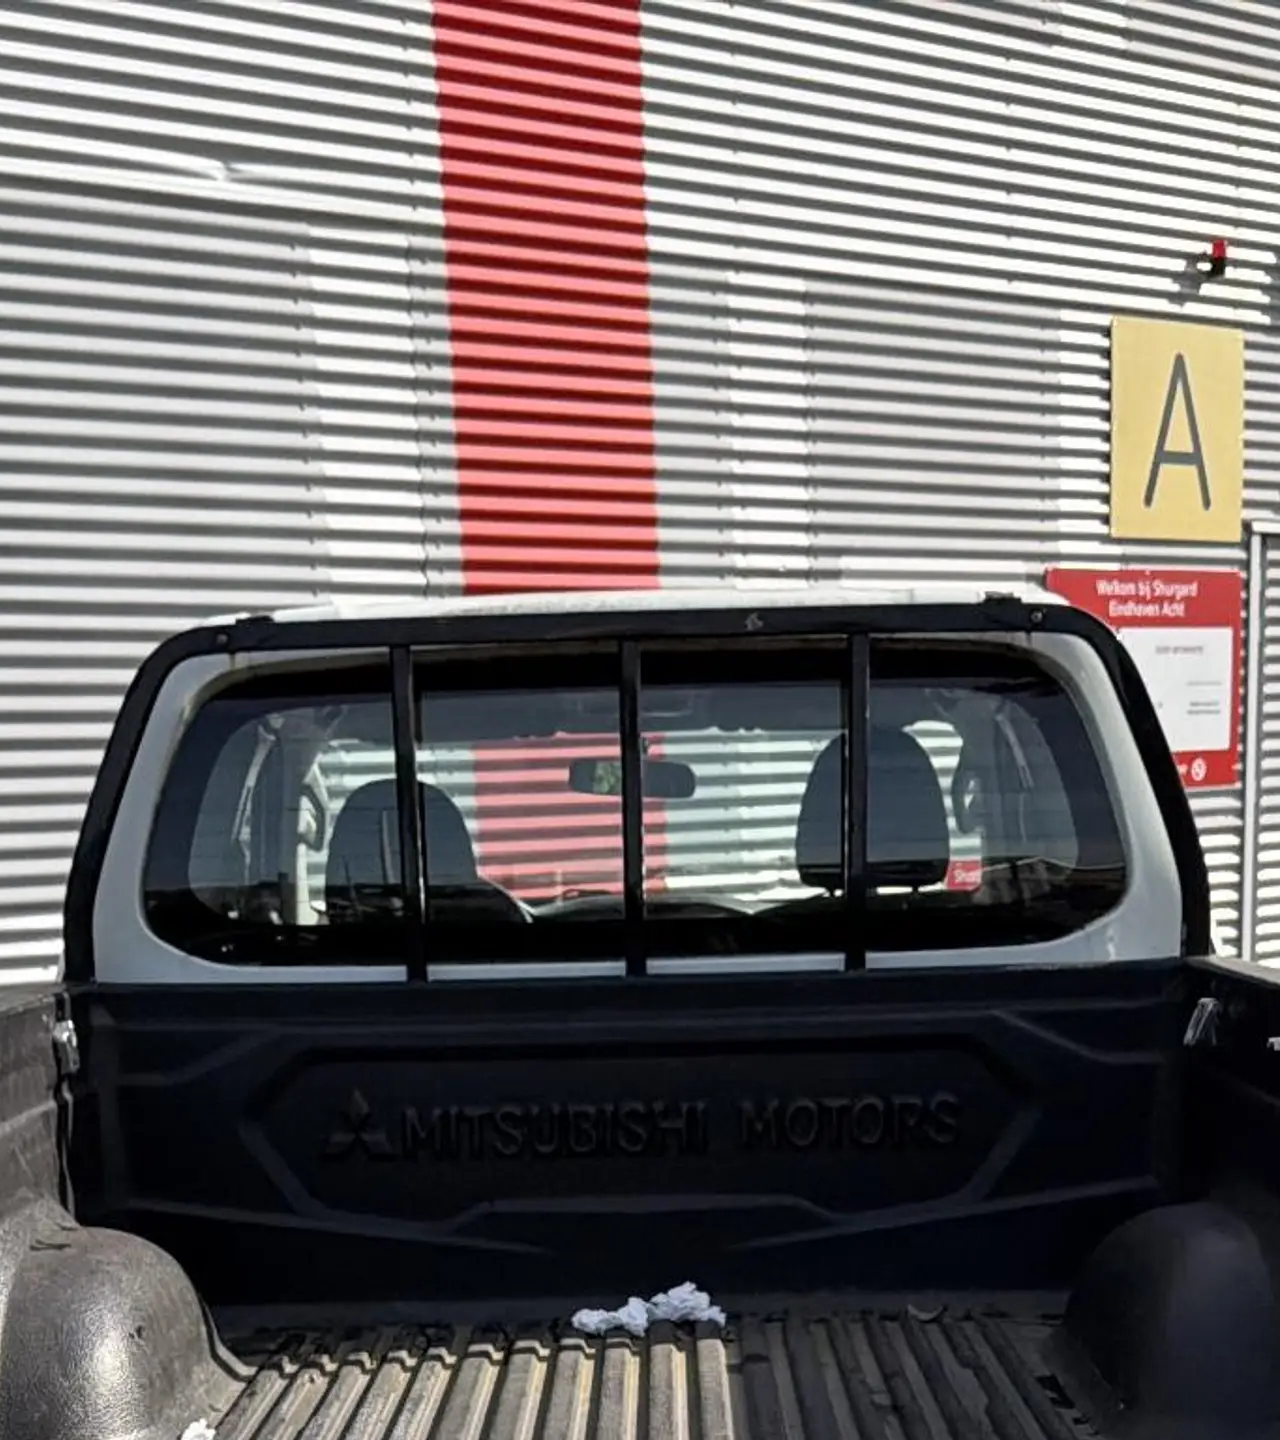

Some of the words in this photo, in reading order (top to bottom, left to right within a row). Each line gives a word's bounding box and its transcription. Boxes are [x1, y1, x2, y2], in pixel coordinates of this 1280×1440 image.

[1143, 352, 1212, 511] A
[1096, 579, 1136, 596] Welkom
[1138, 579, 1151, 600] bij
[1152, 579, 1198, 601] Shurgard
[1109, 600, 1160, 617] Eindhoven
[1161, 601, 1185, 617] Acht
[404, 1099, 709, 1156] MITSUBISHI
[737, 1092, 962, 1150] MOTORS
